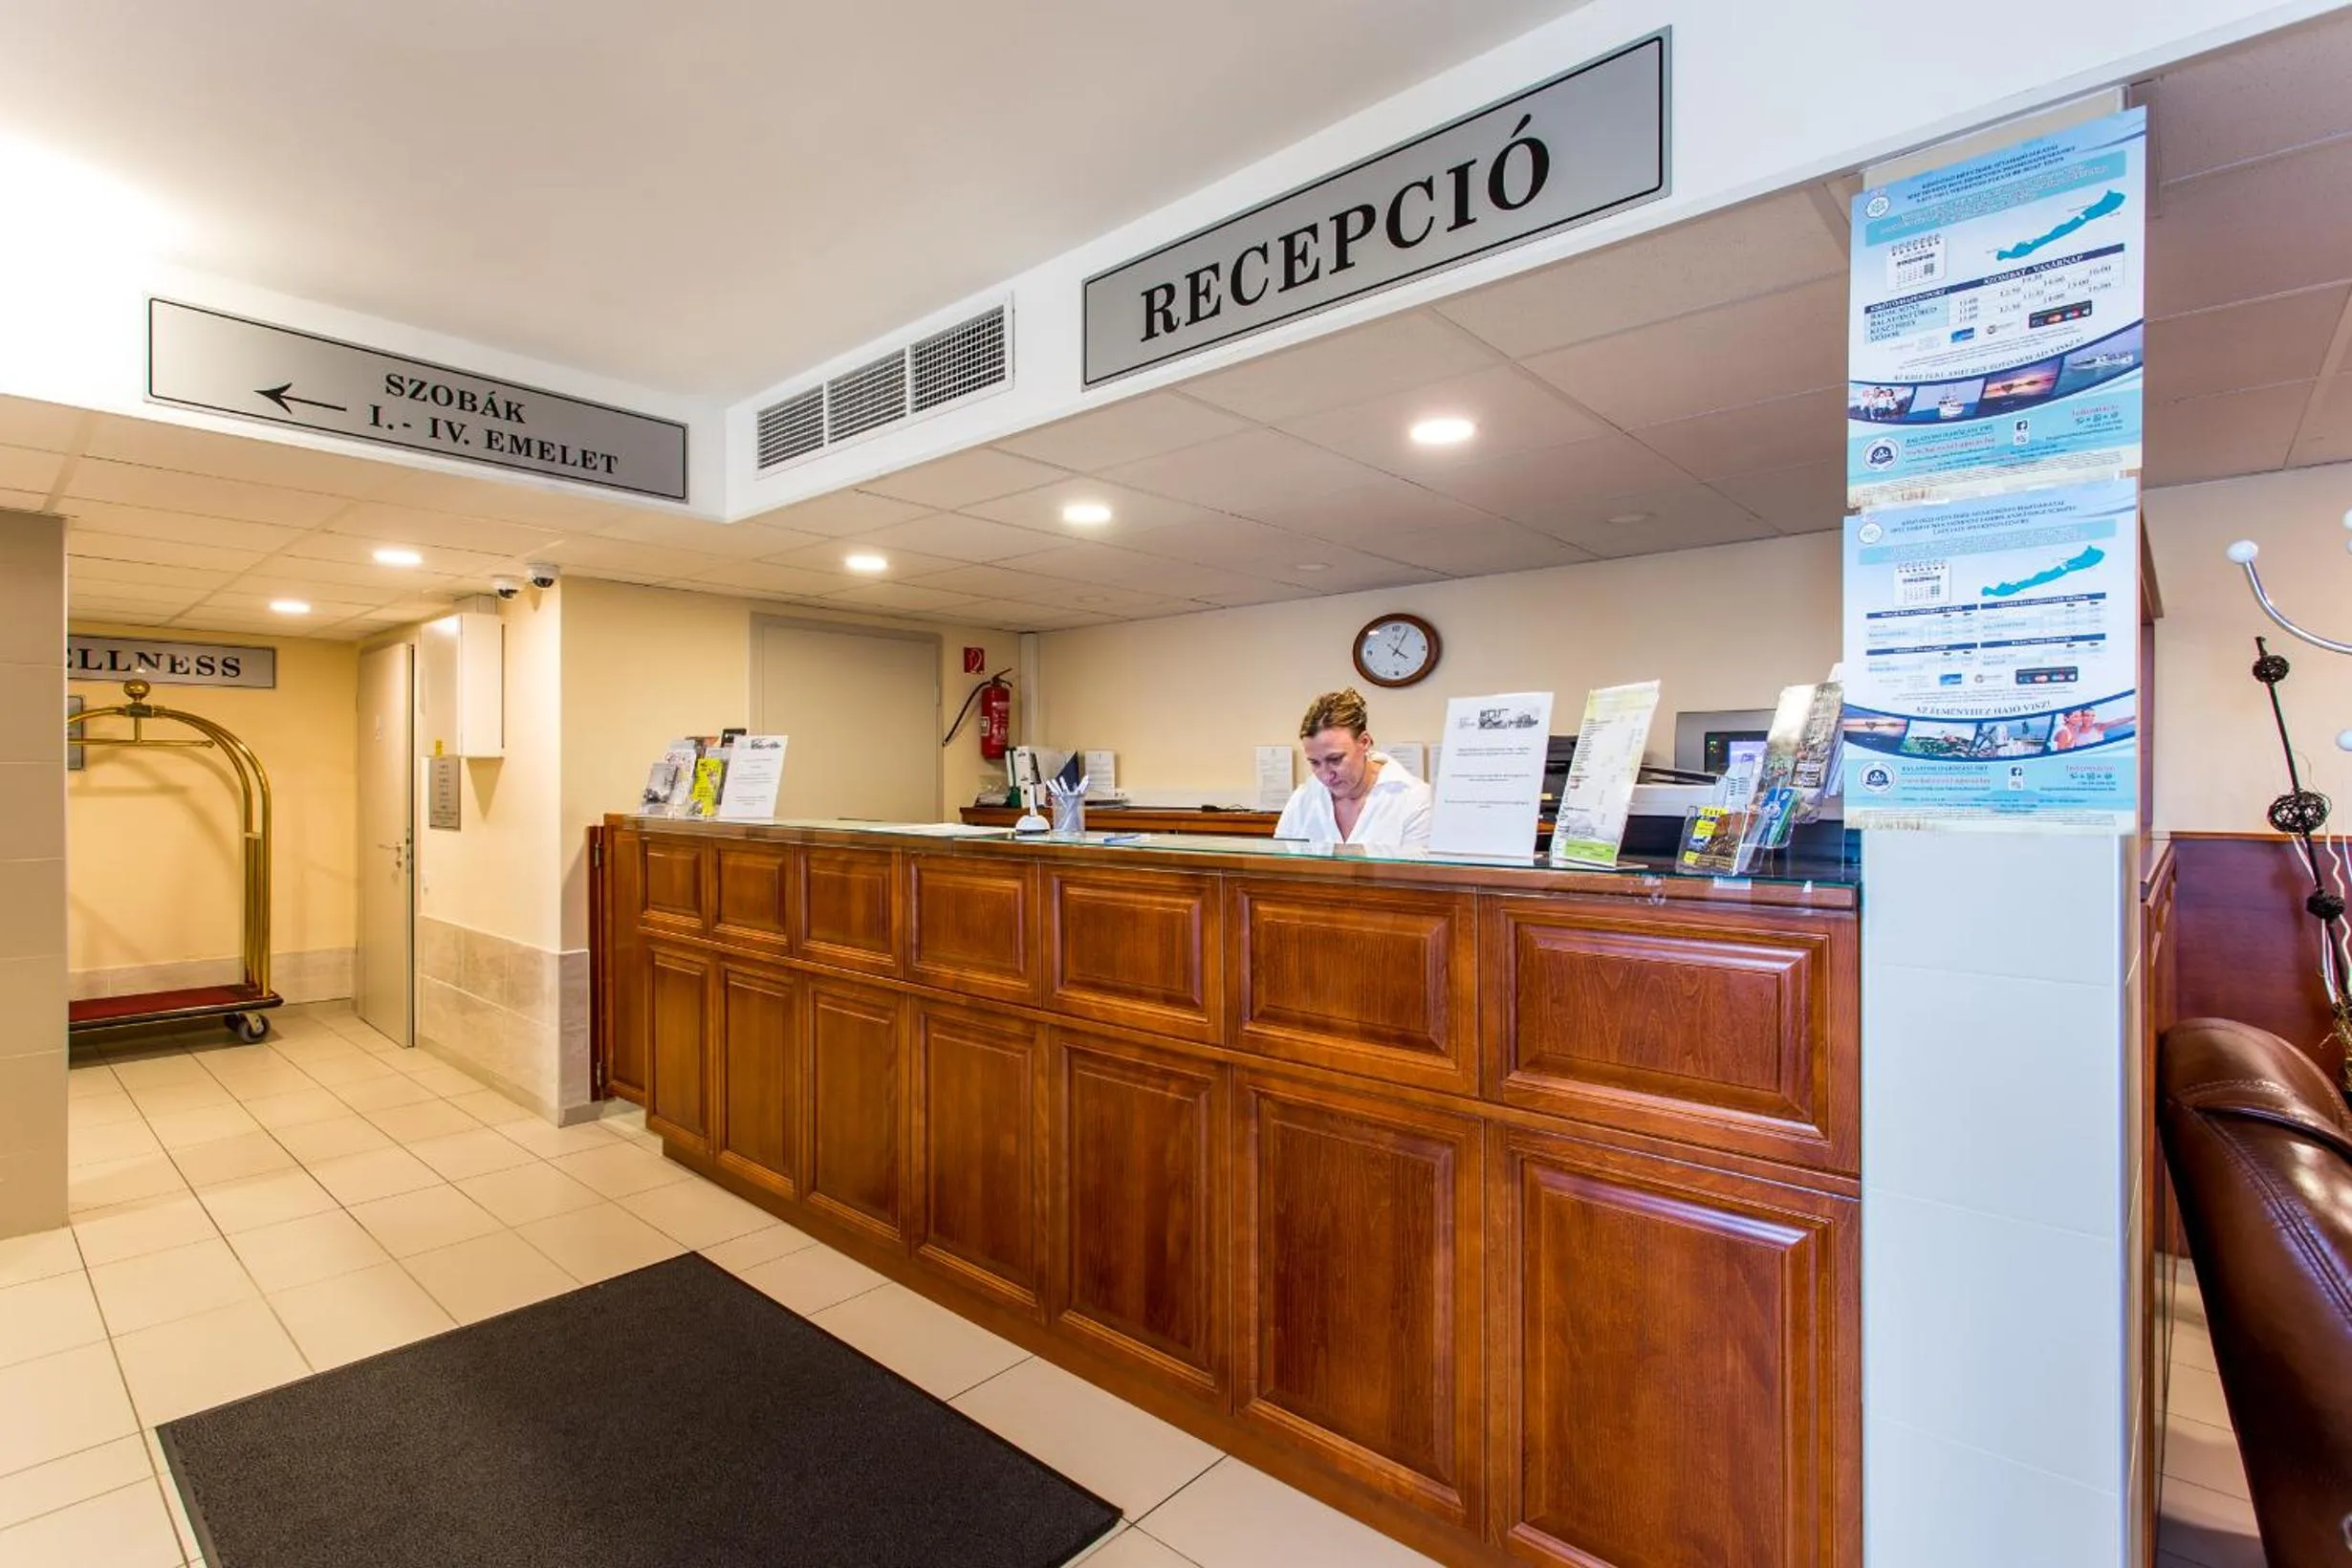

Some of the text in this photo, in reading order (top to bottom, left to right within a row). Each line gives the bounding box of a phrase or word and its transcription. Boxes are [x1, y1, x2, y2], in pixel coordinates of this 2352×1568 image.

[1141, 113, 1550, 342] RECEPCIÓ
[384, 373, 527, 425] SZOBÁK
[428, 417, 470, 446] IV.
[484, 428, 619, 475] EMELET
[68, 647, 241, 678] LLNESS
